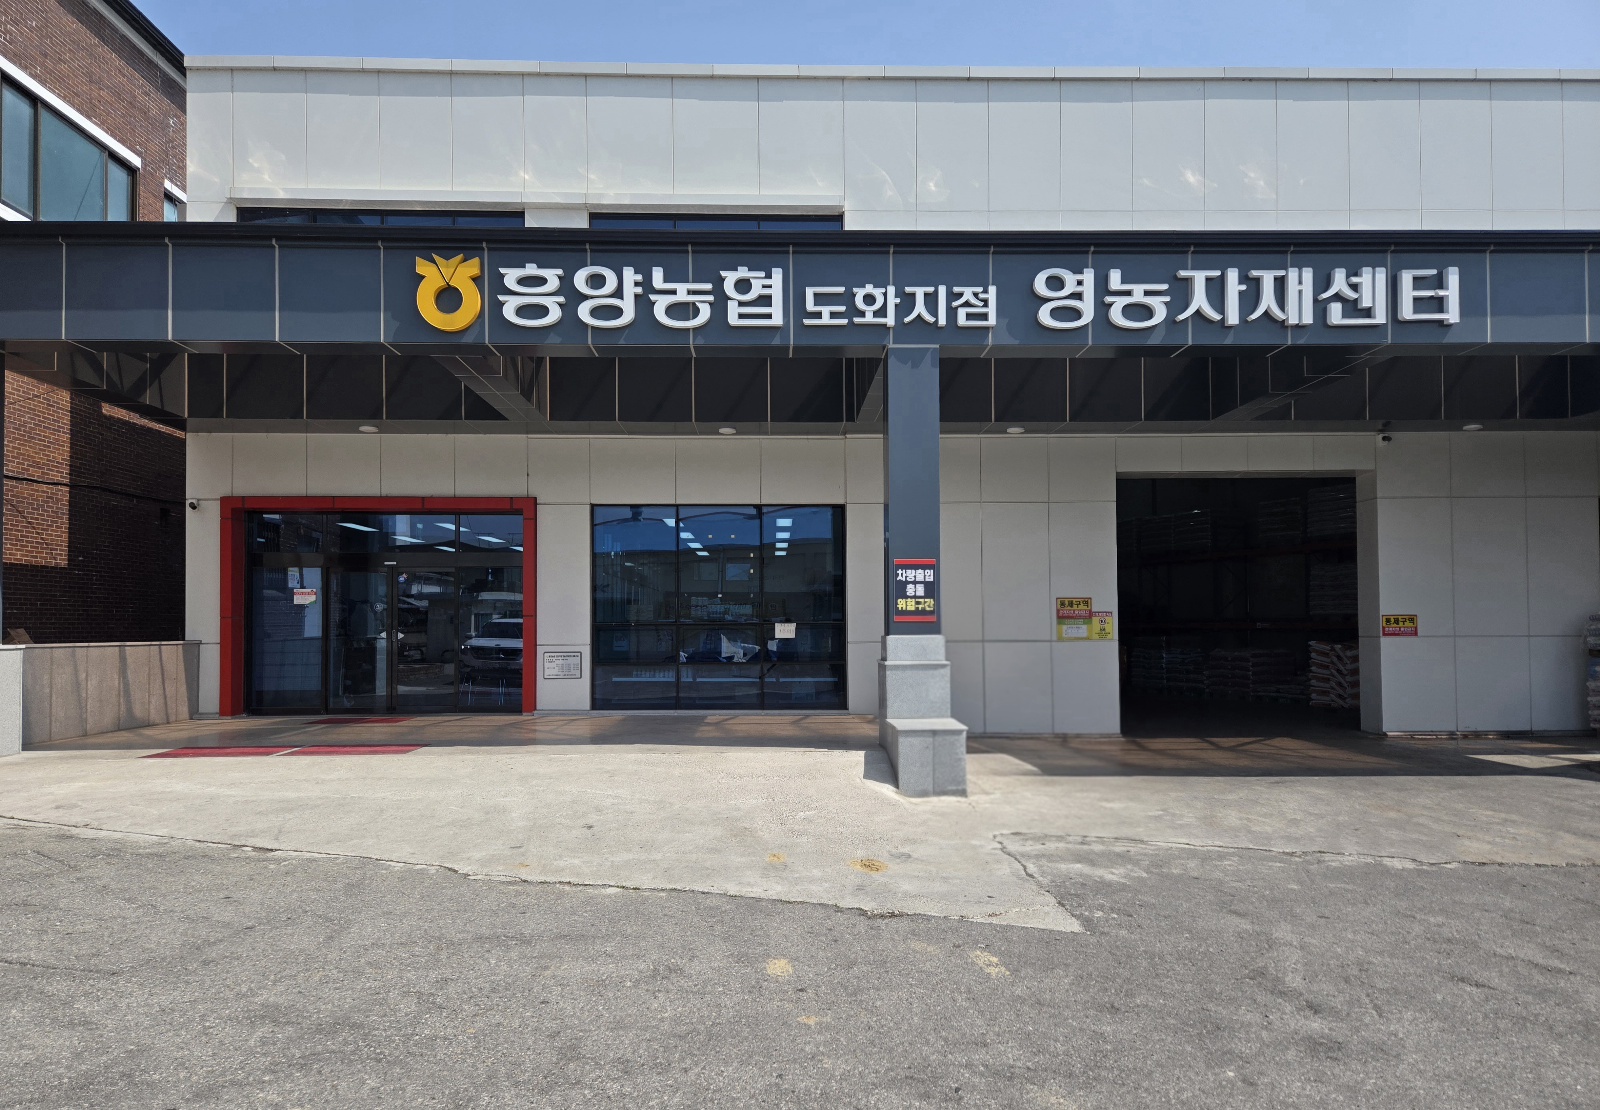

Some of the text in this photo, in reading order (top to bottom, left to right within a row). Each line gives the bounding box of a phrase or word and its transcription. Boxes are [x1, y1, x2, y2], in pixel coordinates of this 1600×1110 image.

[497, 263, 1461, 330] 흥양농협 도화지점 영농자재센터
[896, 569, 934, 581] 차량출입
[906, 583, 925, 596] 충돌
[897, 598, 934, 611] 위험구간
[1059, 599, 1089, 609] 통제구역
[1385, 617, 1415, 625] 통제구역
